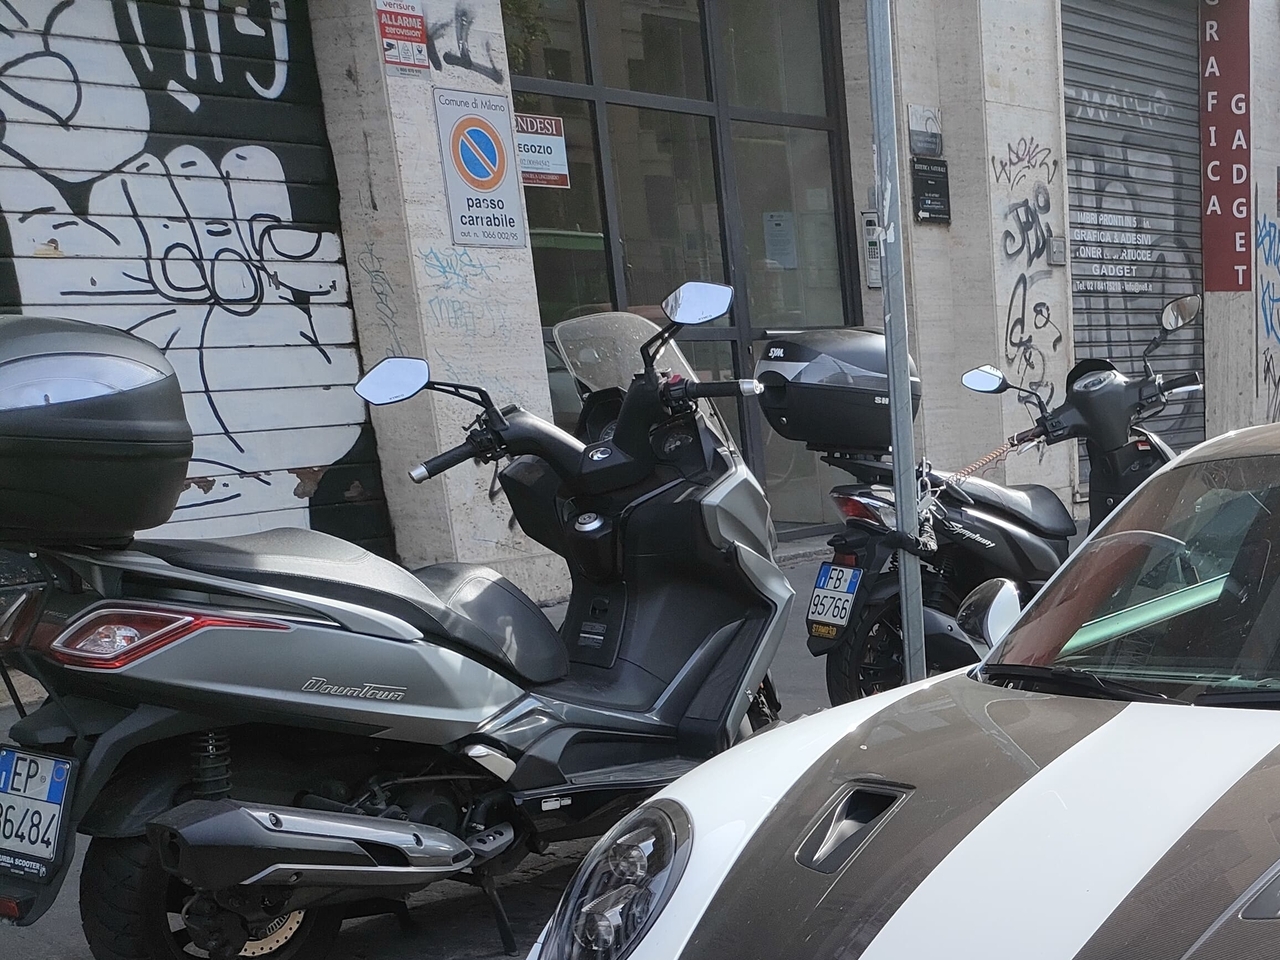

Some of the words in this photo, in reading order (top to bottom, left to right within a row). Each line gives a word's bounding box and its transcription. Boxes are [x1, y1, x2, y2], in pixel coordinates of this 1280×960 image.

[381, 13, 423, 29] ALLARME
[438, 94, 470, 108] Comune
[471, 97, 479, 109] di
[480, 99, 506, 112] Milano
[514, 117, 557, 134] NDESI
[517, 143, 553, 155] EGOZIO
[1231, 94, 1248, 285] GADGET
[466, 196, 505, 212] passo
[460, 213, 516, 228] carrabile
[481, 230, 497, 239] 1066
[1074, 229, 1112, 243] GRAFICA
[1120, 233, 1152, 246] ADESIVI
[1092, 263, 1137, 277] GADGET
[769, 347, 785, 359] SYM
[874, 396, 890, 405] SH
[826, 568, 845, 589] FB
[811, 594, 850, 620] 95766
[301, 676, 408, 701] DownTown
[10, 756, 40, 793] EP
[14, 858, 40, 870] SCOOTER
